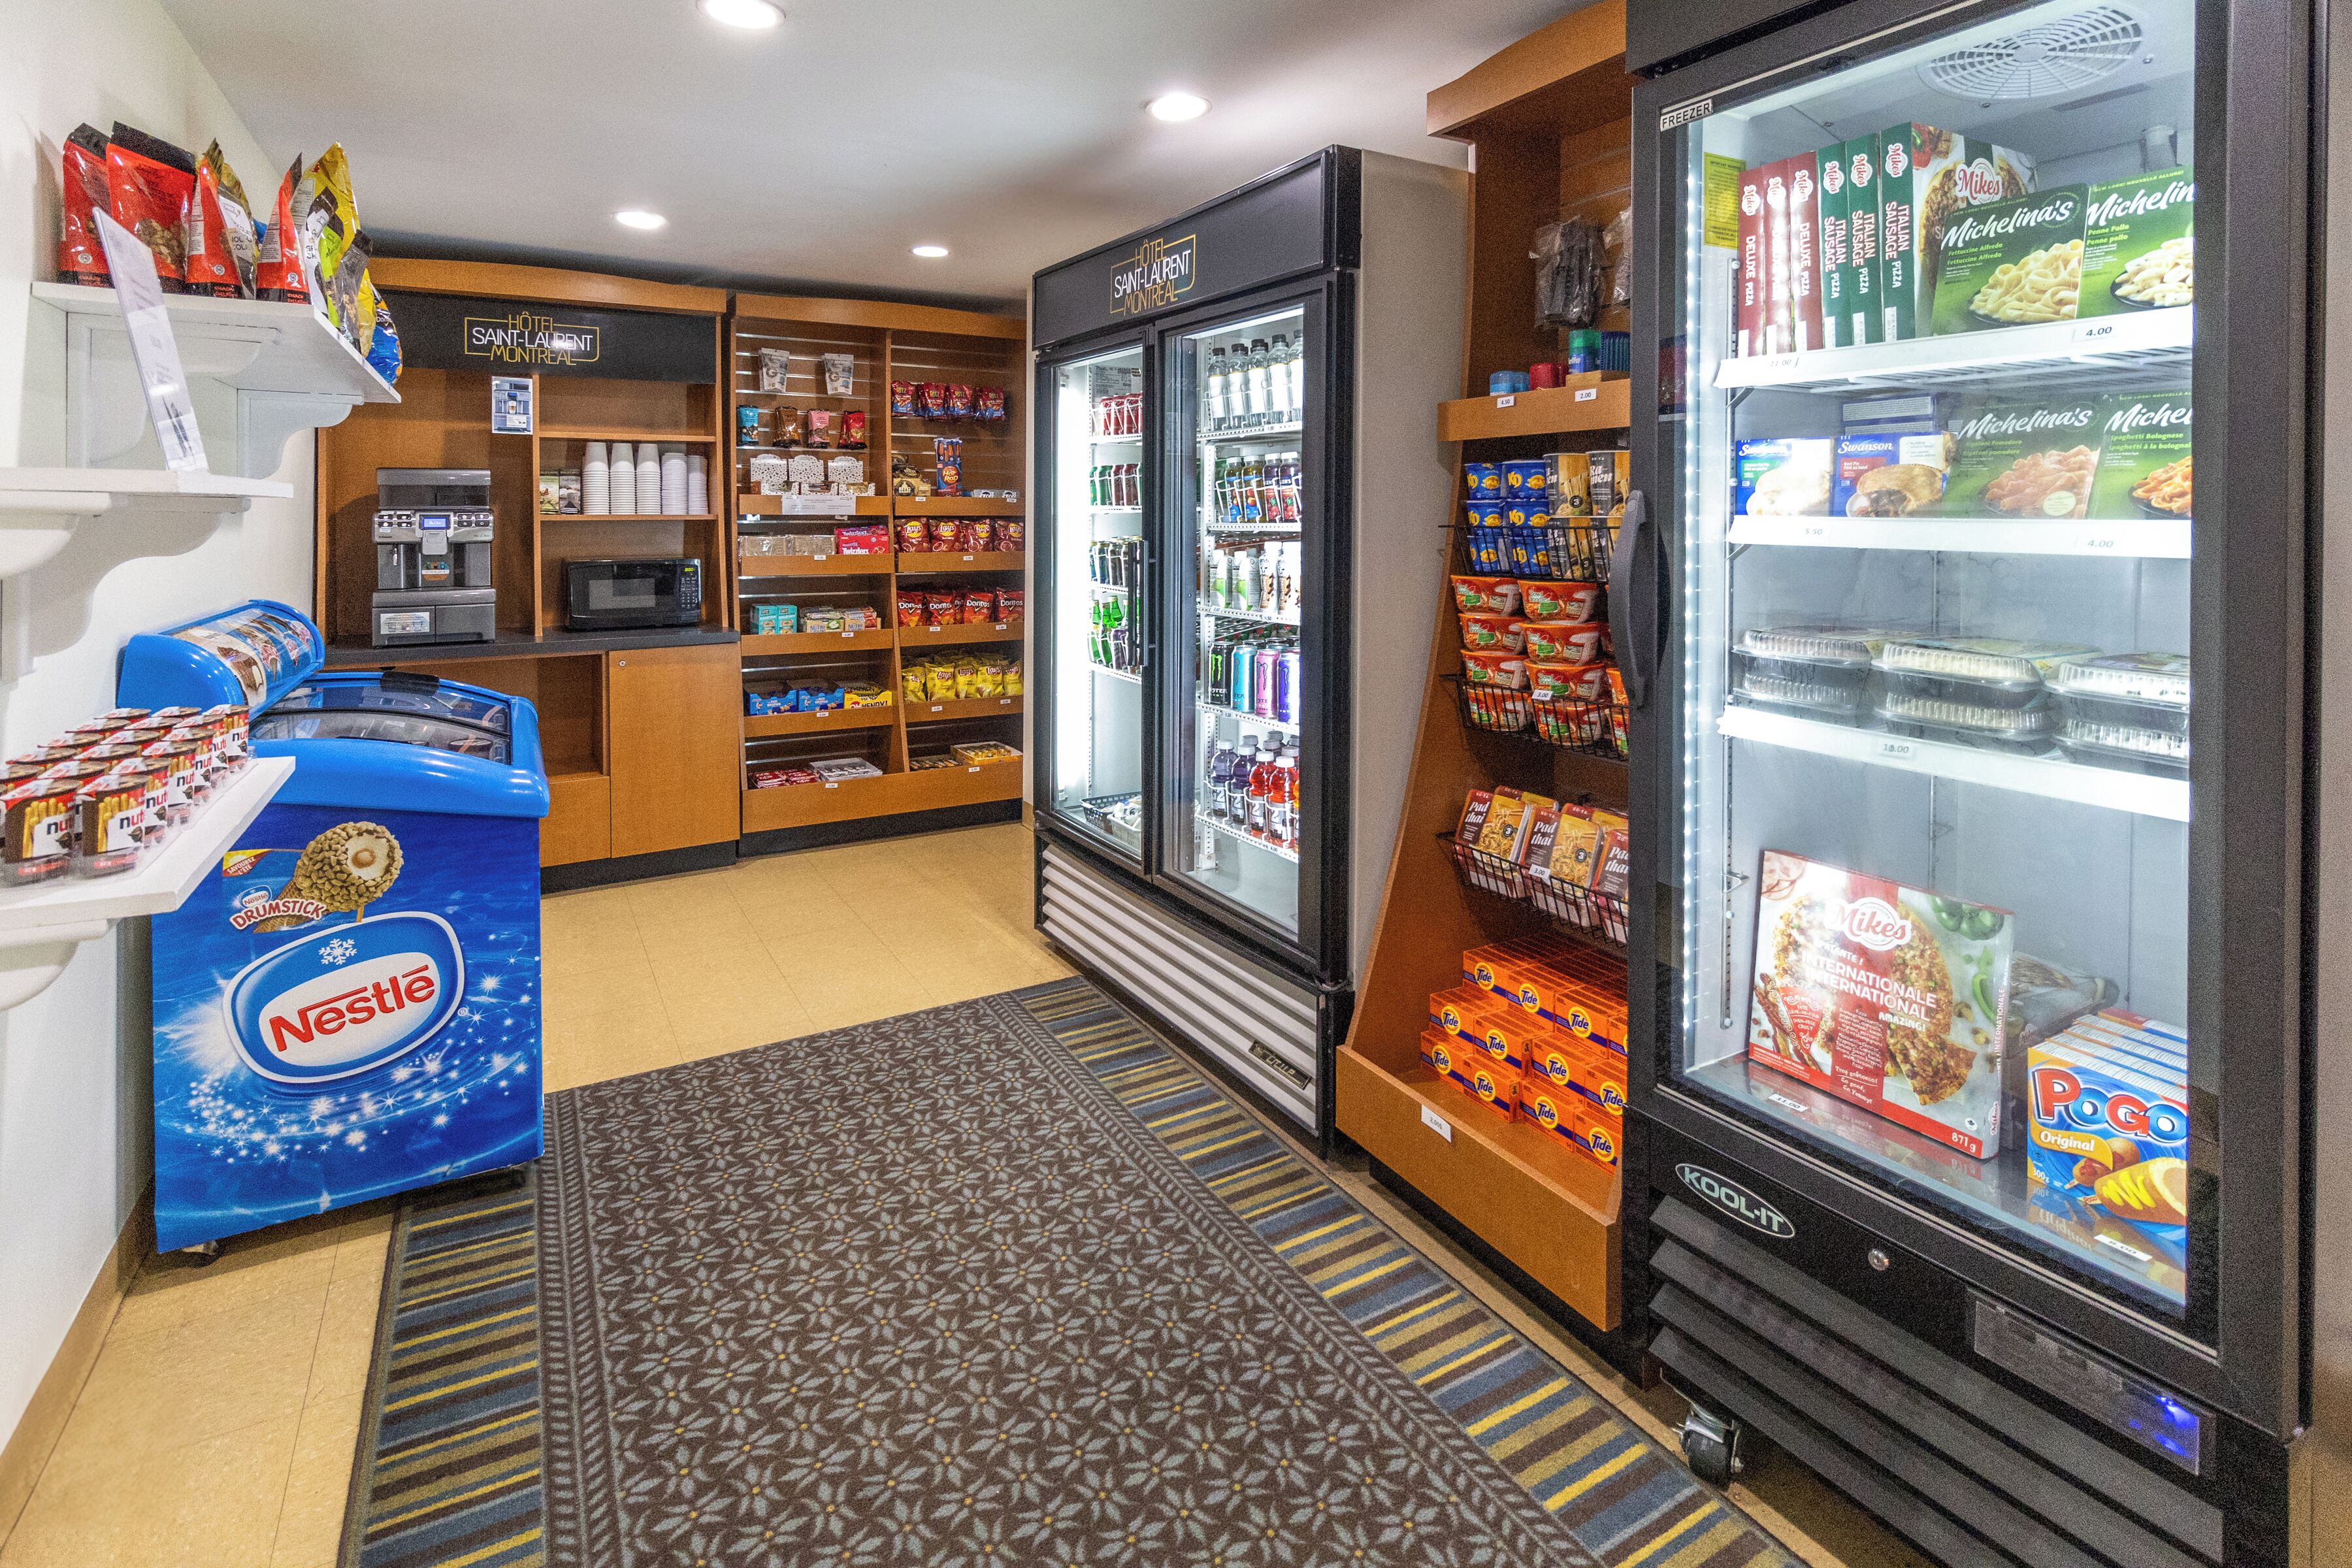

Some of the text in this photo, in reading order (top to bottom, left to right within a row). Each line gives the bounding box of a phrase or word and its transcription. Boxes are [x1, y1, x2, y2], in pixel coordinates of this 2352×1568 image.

[1662, 103, 1710, 129] FREEZER
[1889, 144, 1901, 176] Mikes
[1827, 163, 1839, 193] Mikes
[1854, 155, 1865, 186] Mikes
[1959, 166, 2001, 200] Mikes
[1897, 204, 1910, 251] ITALIAN
[1941, 200, 2073, 250] Michelina's
[1835, 220, 1846, 265] ITALIAN
[1863, 213, 1876, 259] ITALIAN
[1886, 201, 1903, 288] SAUSAGE PIZZA
[2086, 234, 2129, 246] Penne pollo
[1134, 237, 1167, 269] HÔTEL
[1824, 216, 1840, 299] SAUSAGE PIZZA
[1852, 210, 1869, 294] SAUSAGE PIZZA
[1947, 252, 2002, 265] Fettuccine Alfredo
[1948, 242, 2003, 256] Fettuccine Alfredo
[1799, 222, 1811, 297] DELUXE PIZZA
[1114, 249, 1192, 299] SAINT-LAURENT
[1745, 236, 1756, 306] DELUXE PIZZA
[508, 311, 559, 334] HÔTEL
[2086, 327, 2112, 336] 4.00
[472, 327, 593, 351] SAINT-LAURENT
[1957, 407, 2093, 440] Michelina's
[1838, 441, 1893, 454] Swanson
[2108, 443, 2142, 451] Spaghetti
[2111, 433, 2144, 442] Spaghetti
[1507, 471, 1523, 489] KD
[1590, 472, 1613, 485] men
[1509, 509, 1525, 527] KD
[2087, 539, 2114, 548] 4.00
[1469, 801, 1490, 813] Pad
[1465, 812, 1485, 824] thai
[1534, 821, 1558, 834] Pad
[1505, 826, 1512, 835] 3
[1531, 833, 1553, 846] thai
[227, 856, 256, 874] SAVOUREZ
[1577, 851, 1585, 860] 3
[1533, 867, 1546, 876] 3.00
[244, 892, 269, 906] Nestlé
[231, 899, 325, 928] DRUMSTICK
[1833, 904, 1906, 939] Mikes
[1477, 968, 1492, 983] Tide
[1802, 951, 1938, 1009] INTERNATIONALE
[1521, 989, 1538, 1005] Tide
[1805, 967, 1931, 1022] INTERNATIONAL
[268, 964, 436, 1053] Nestlé
[1993, 987, 2005, 1049] INTERNATIONALE
[1443, 1012, 1459, 1026] Tide
[1571, 1012, 1590, 1030] Tide
[1487, 1035, 1505, 1052] Tide
[1434, 1051, 1450, 1067] Tide
[1548, 1058, 1567, 1078] Tide
[1475, 1077, 1494, 1095] Tide
[1603, 1088, 1624, 1107] Tide
[1776, 1097, 1801, 1109] 11.00
[2031, 1066, 2188, 1143] POGO
[1537, 1103, 1556, 1121] Tide
[1591, 1134, 1612, 1154] Tide
[1951, 1131, 1977, 1153] 871 g
[2040, 1130, 2095, 1152] Original
[1682, 1166, 1784, 1233] KOOL-IT
